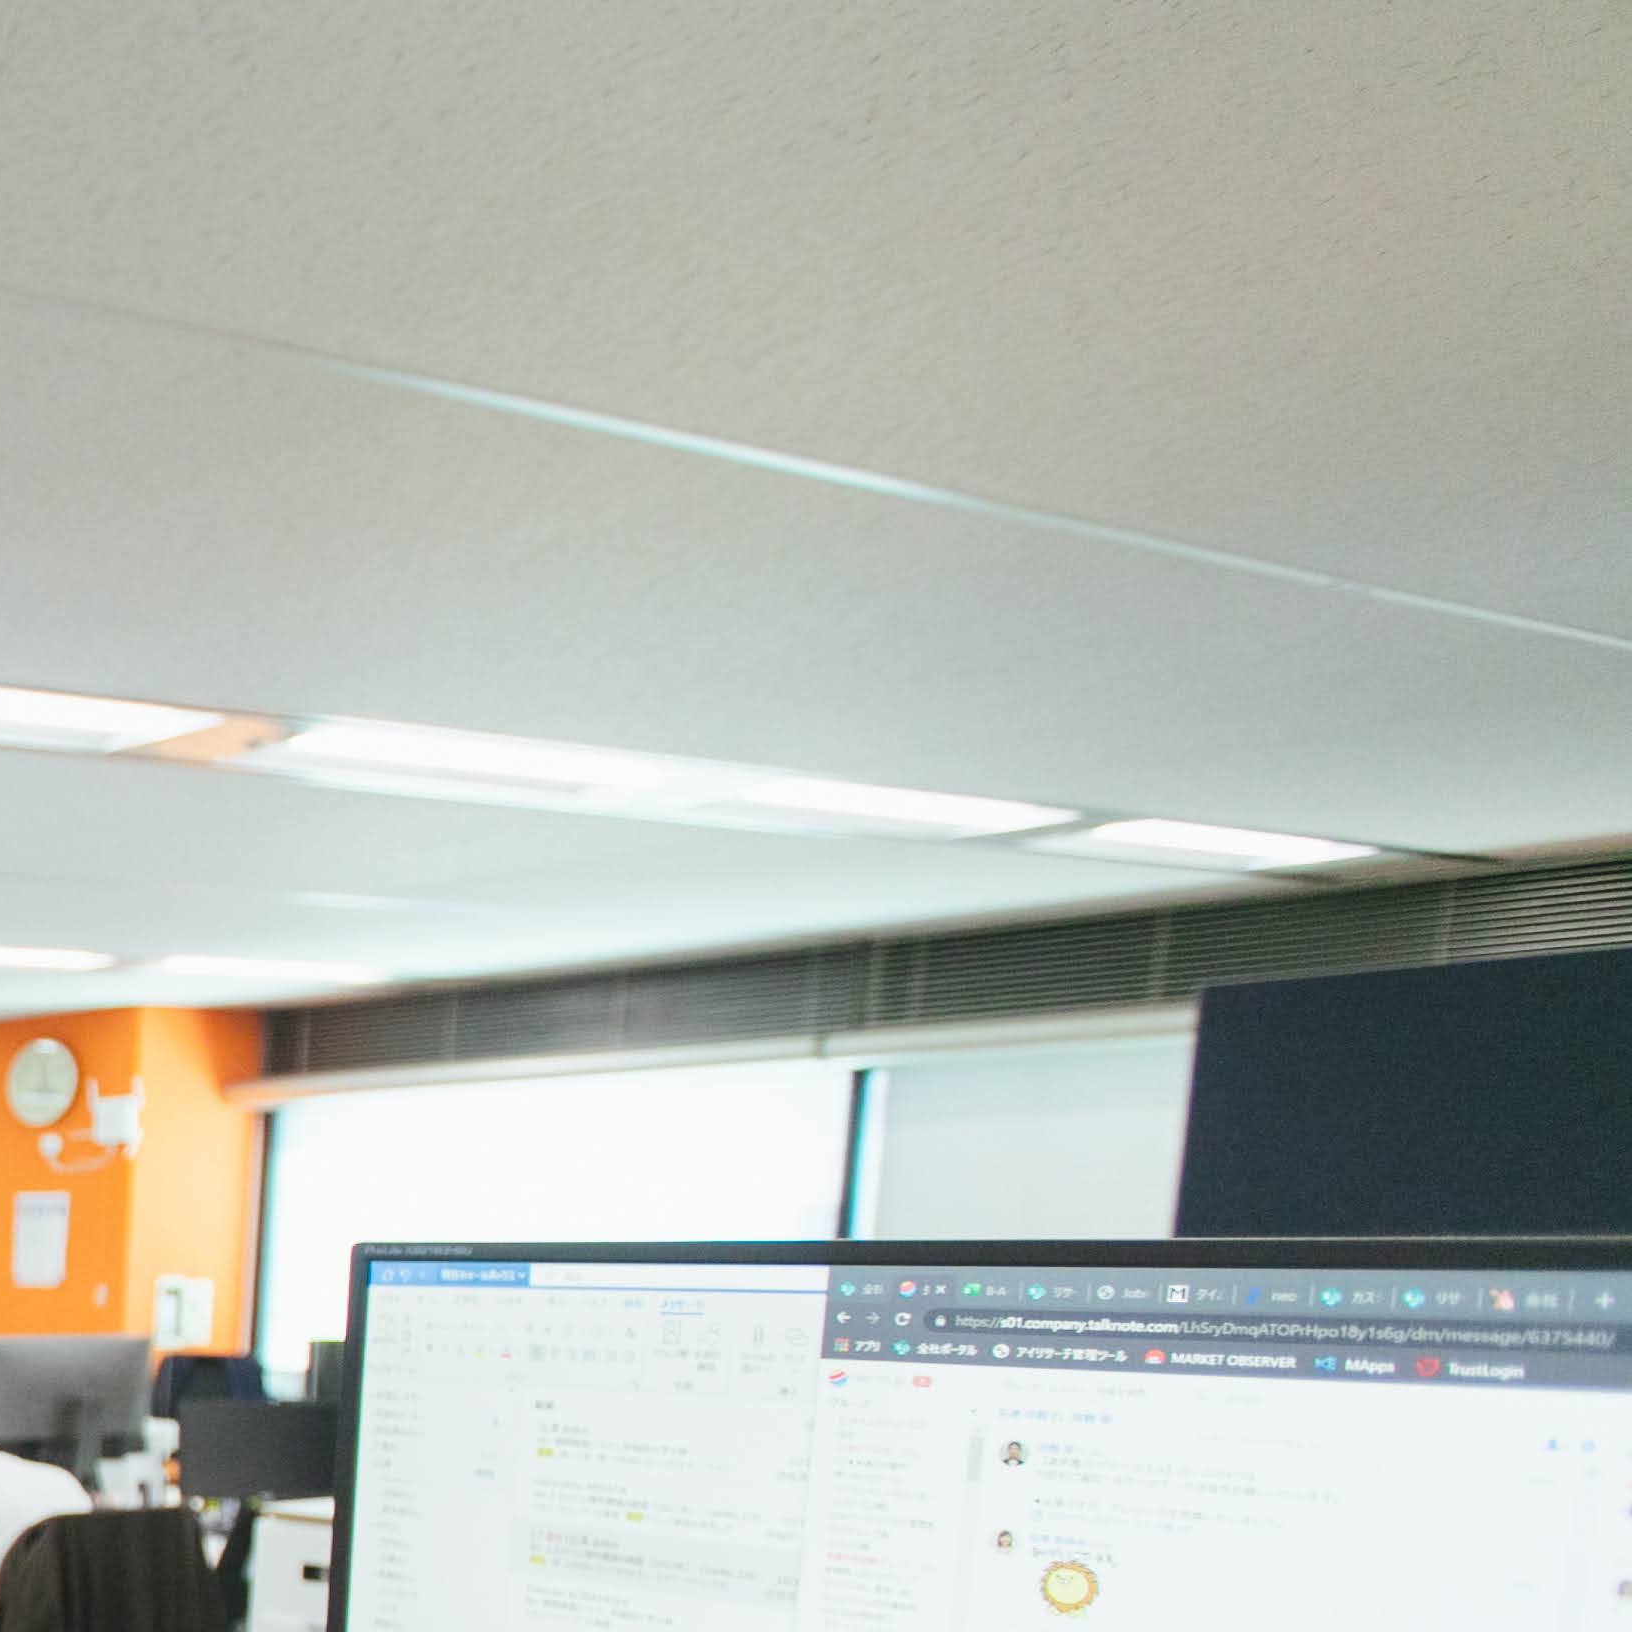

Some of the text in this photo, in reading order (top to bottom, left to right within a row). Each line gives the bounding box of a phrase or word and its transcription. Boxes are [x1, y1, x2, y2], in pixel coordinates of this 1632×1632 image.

[854, 1340, 881, 1352] アプリ
[1170, 1352, 1297, 1369] MARKET OBSERVER
[1345, 1358, 1395, 1376] MApps
[1448, 1362, 1526, 1381] TrustLogin
